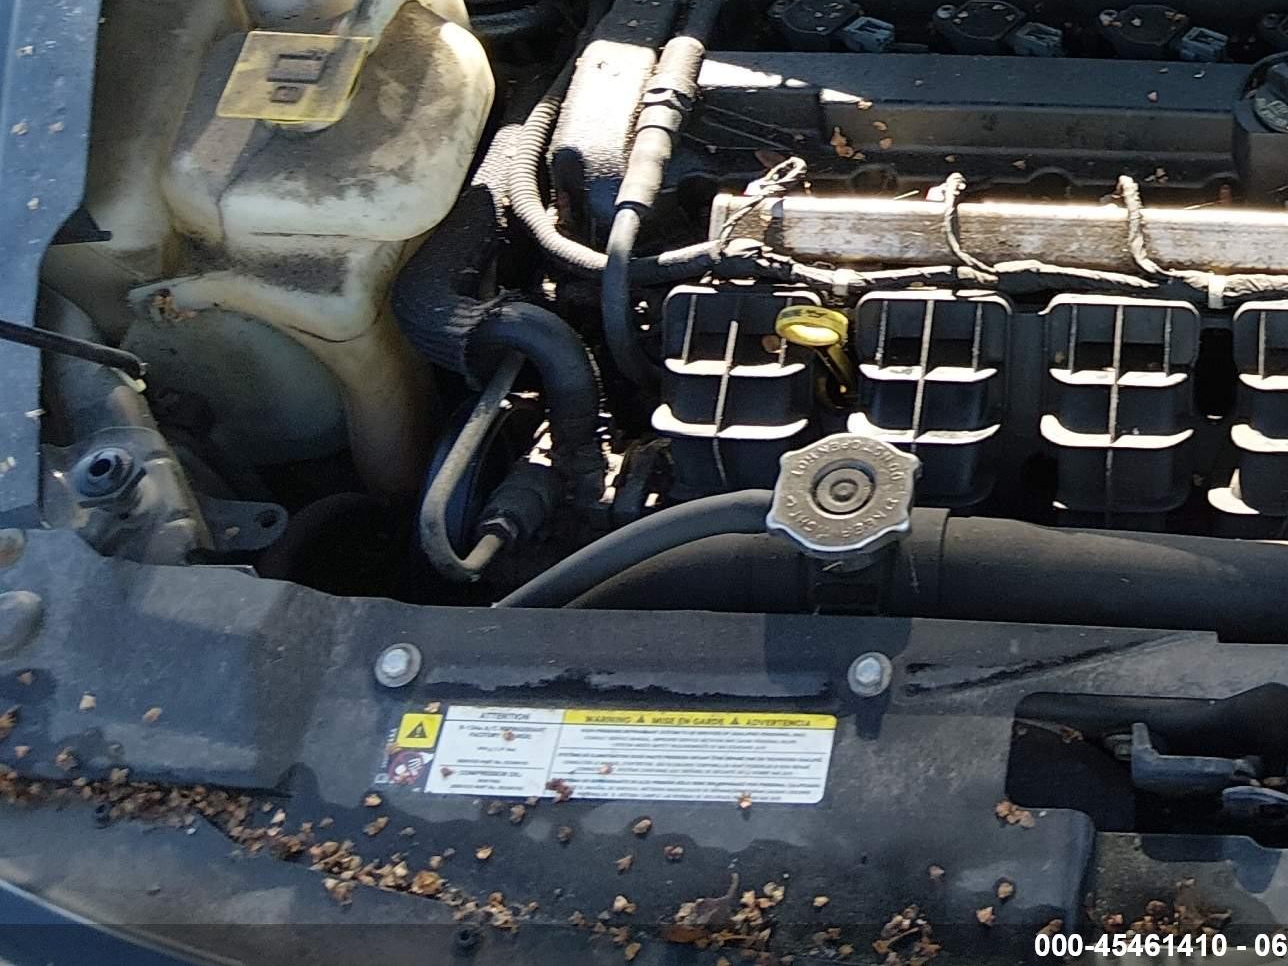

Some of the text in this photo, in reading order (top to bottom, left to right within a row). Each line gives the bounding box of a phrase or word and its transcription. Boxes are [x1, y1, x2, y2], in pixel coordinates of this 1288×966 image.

[479, 712, 530, 721] ATTENTION
[585, 715, 811, 727] WARNING MISE EN GARDE ADVERTENCIA
